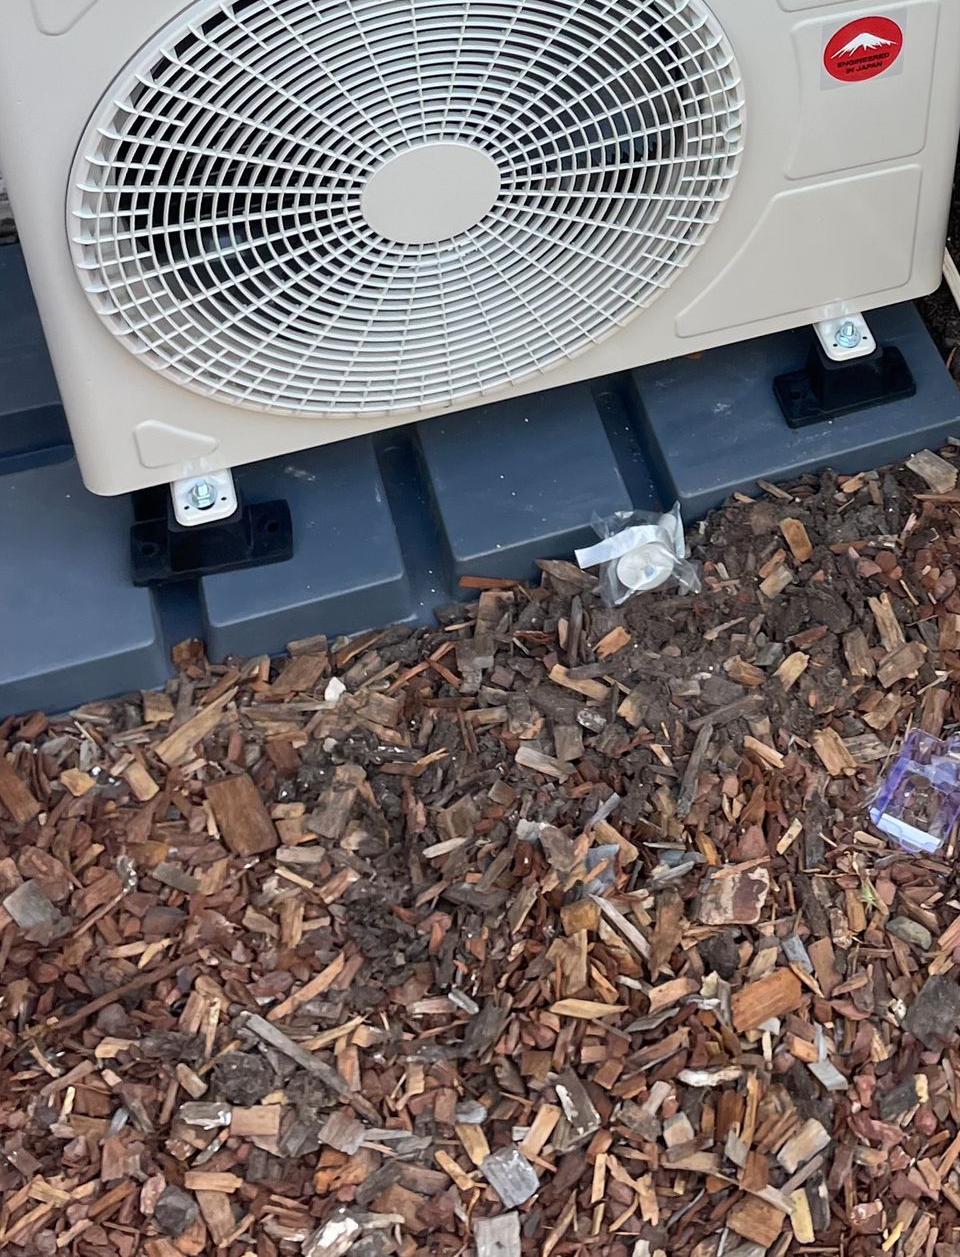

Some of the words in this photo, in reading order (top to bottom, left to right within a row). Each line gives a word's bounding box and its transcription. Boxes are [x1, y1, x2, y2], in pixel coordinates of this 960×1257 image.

[837, 52, 890, 68] ENGINEERED
[845, 66, 855, 74] IN
[856, 61, 883, 72] JAPAN
